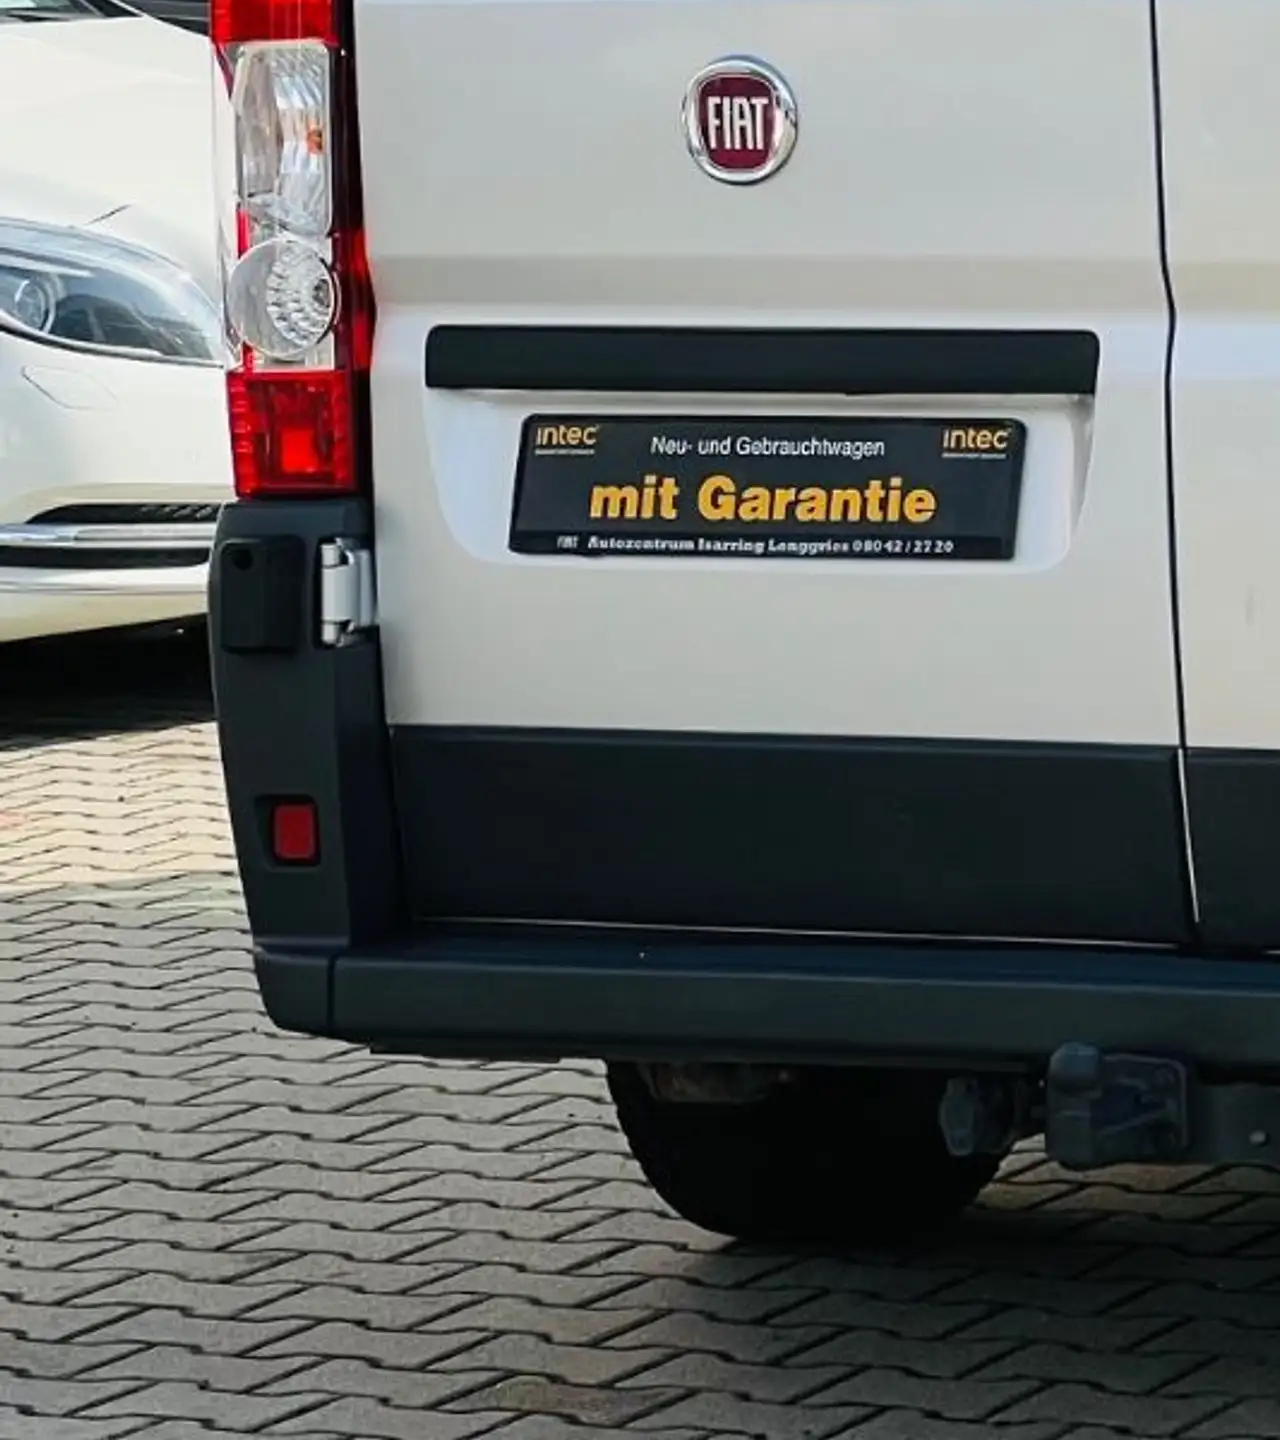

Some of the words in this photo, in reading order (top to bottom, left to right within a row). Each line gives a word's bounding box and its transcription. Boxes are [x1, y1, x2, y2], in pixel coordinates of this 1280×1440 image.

[706, 95, 769, 151] FIAT
[535, 424, 598, 446] intec
[941, 425, 1010, 449] intec
[650, 436, 693, 455] Neu-
[698, 436, 731, 455] und
[736, 436, 885, 460] Gebrauchtwagen
[589, 474, 680, 520] mit
[698, 474, 938, 523] Garantie
